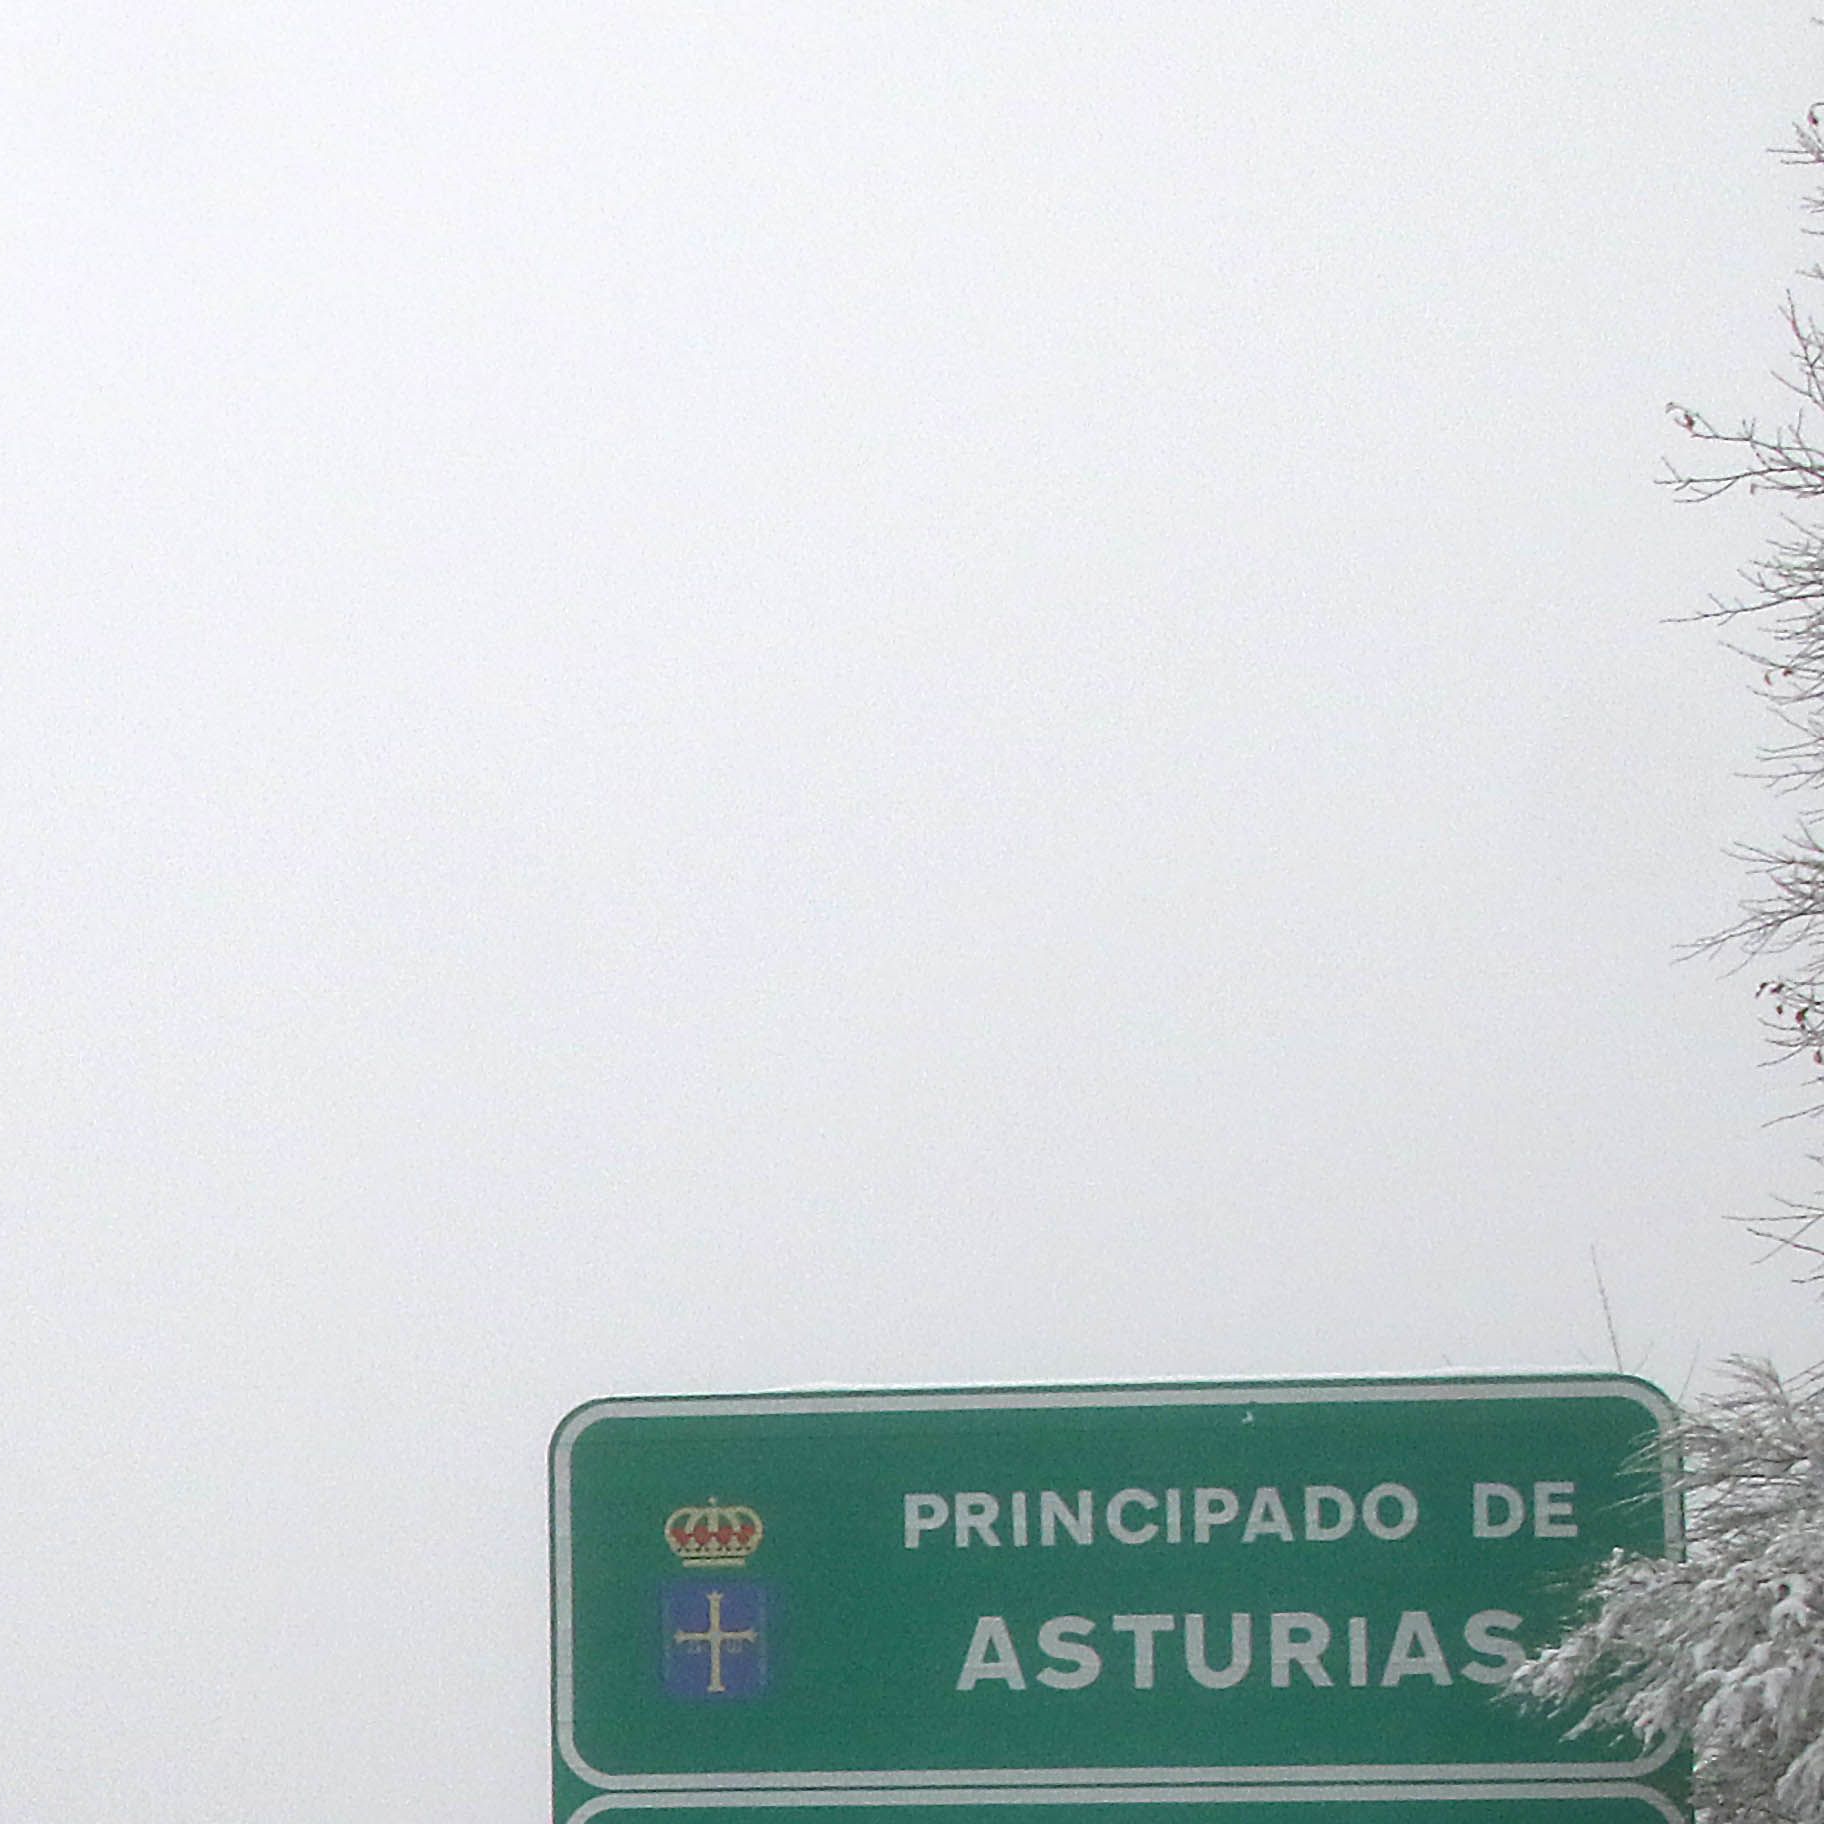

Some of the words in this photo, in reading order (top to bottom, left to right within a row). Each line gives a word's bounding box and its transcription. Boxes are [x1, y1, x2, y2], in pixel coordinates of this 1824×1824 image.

[903, 1482, 1419, 1550] PRINCIPADO
[1471, 1480, 1579, 1540] DE
[959, 1608, 1528, 1693] ASTURIAS
